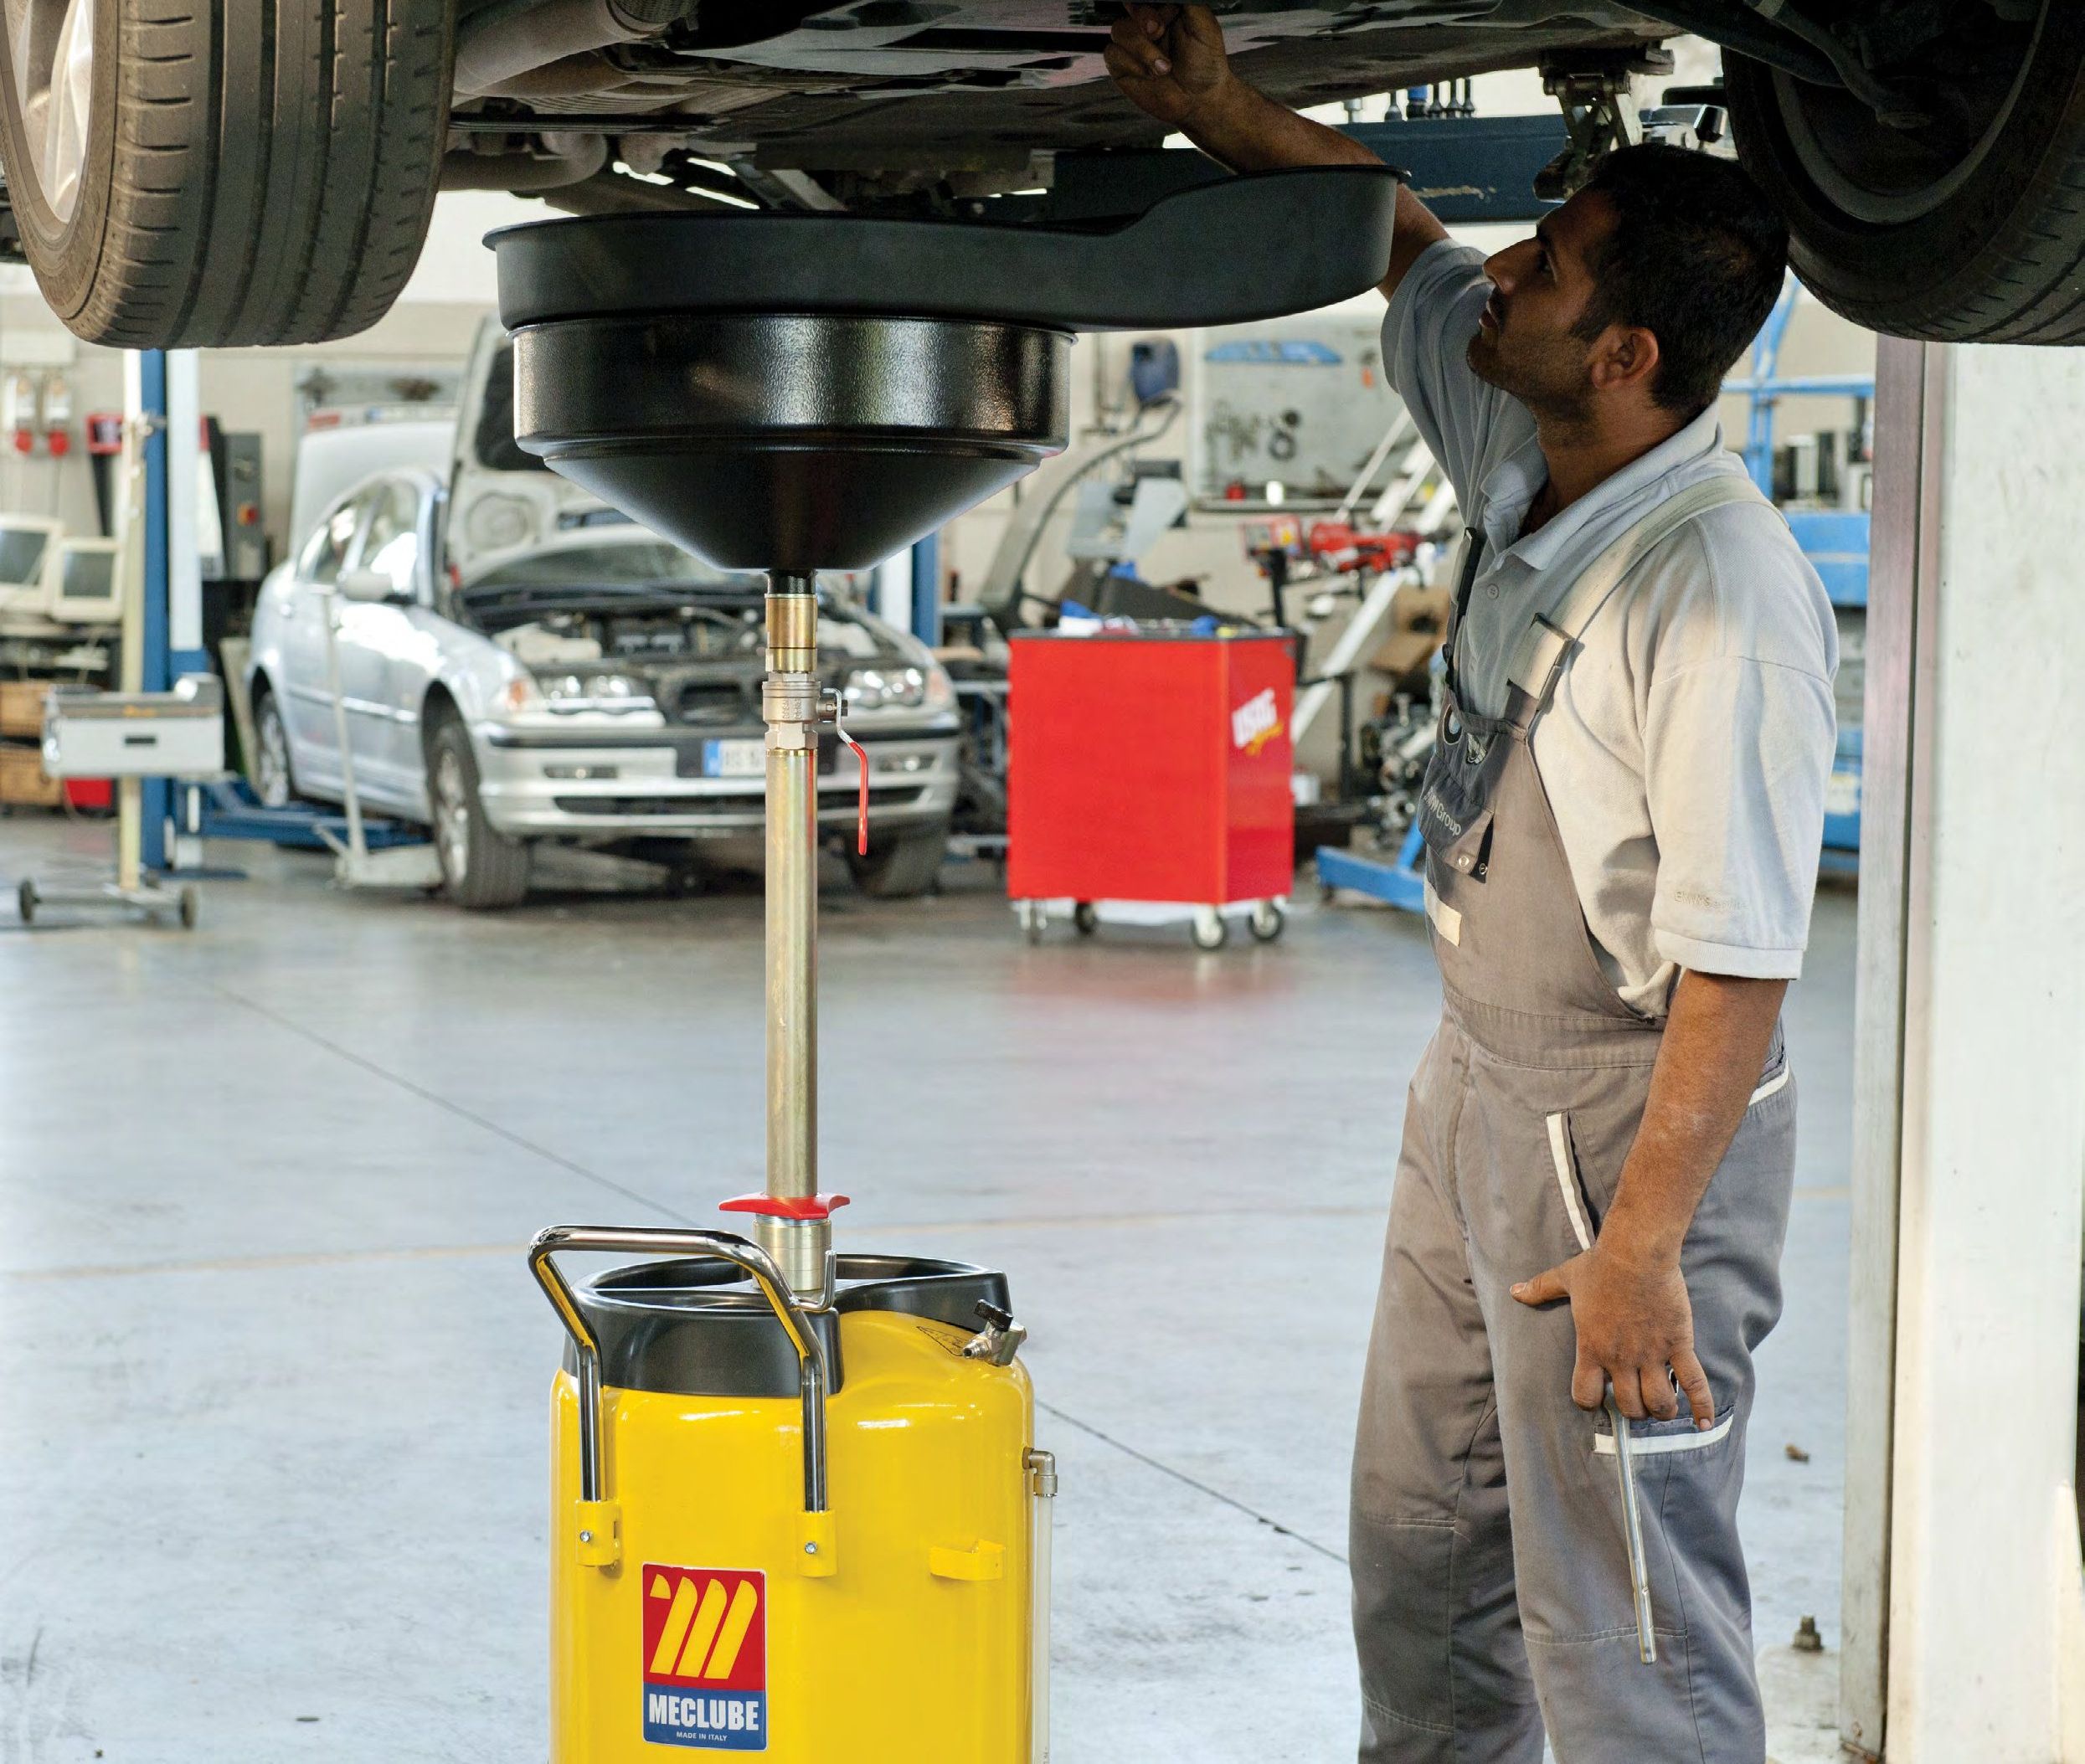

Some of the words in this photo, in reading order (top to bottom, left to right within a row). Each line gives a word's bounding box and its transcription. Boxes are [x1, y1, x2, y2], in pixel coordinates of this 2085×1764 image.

[1436, 803, 1462, 836] Group
[649, 1694, 759, 1731] MECLUBE
[677, 1731, 697, 1740] MADE
